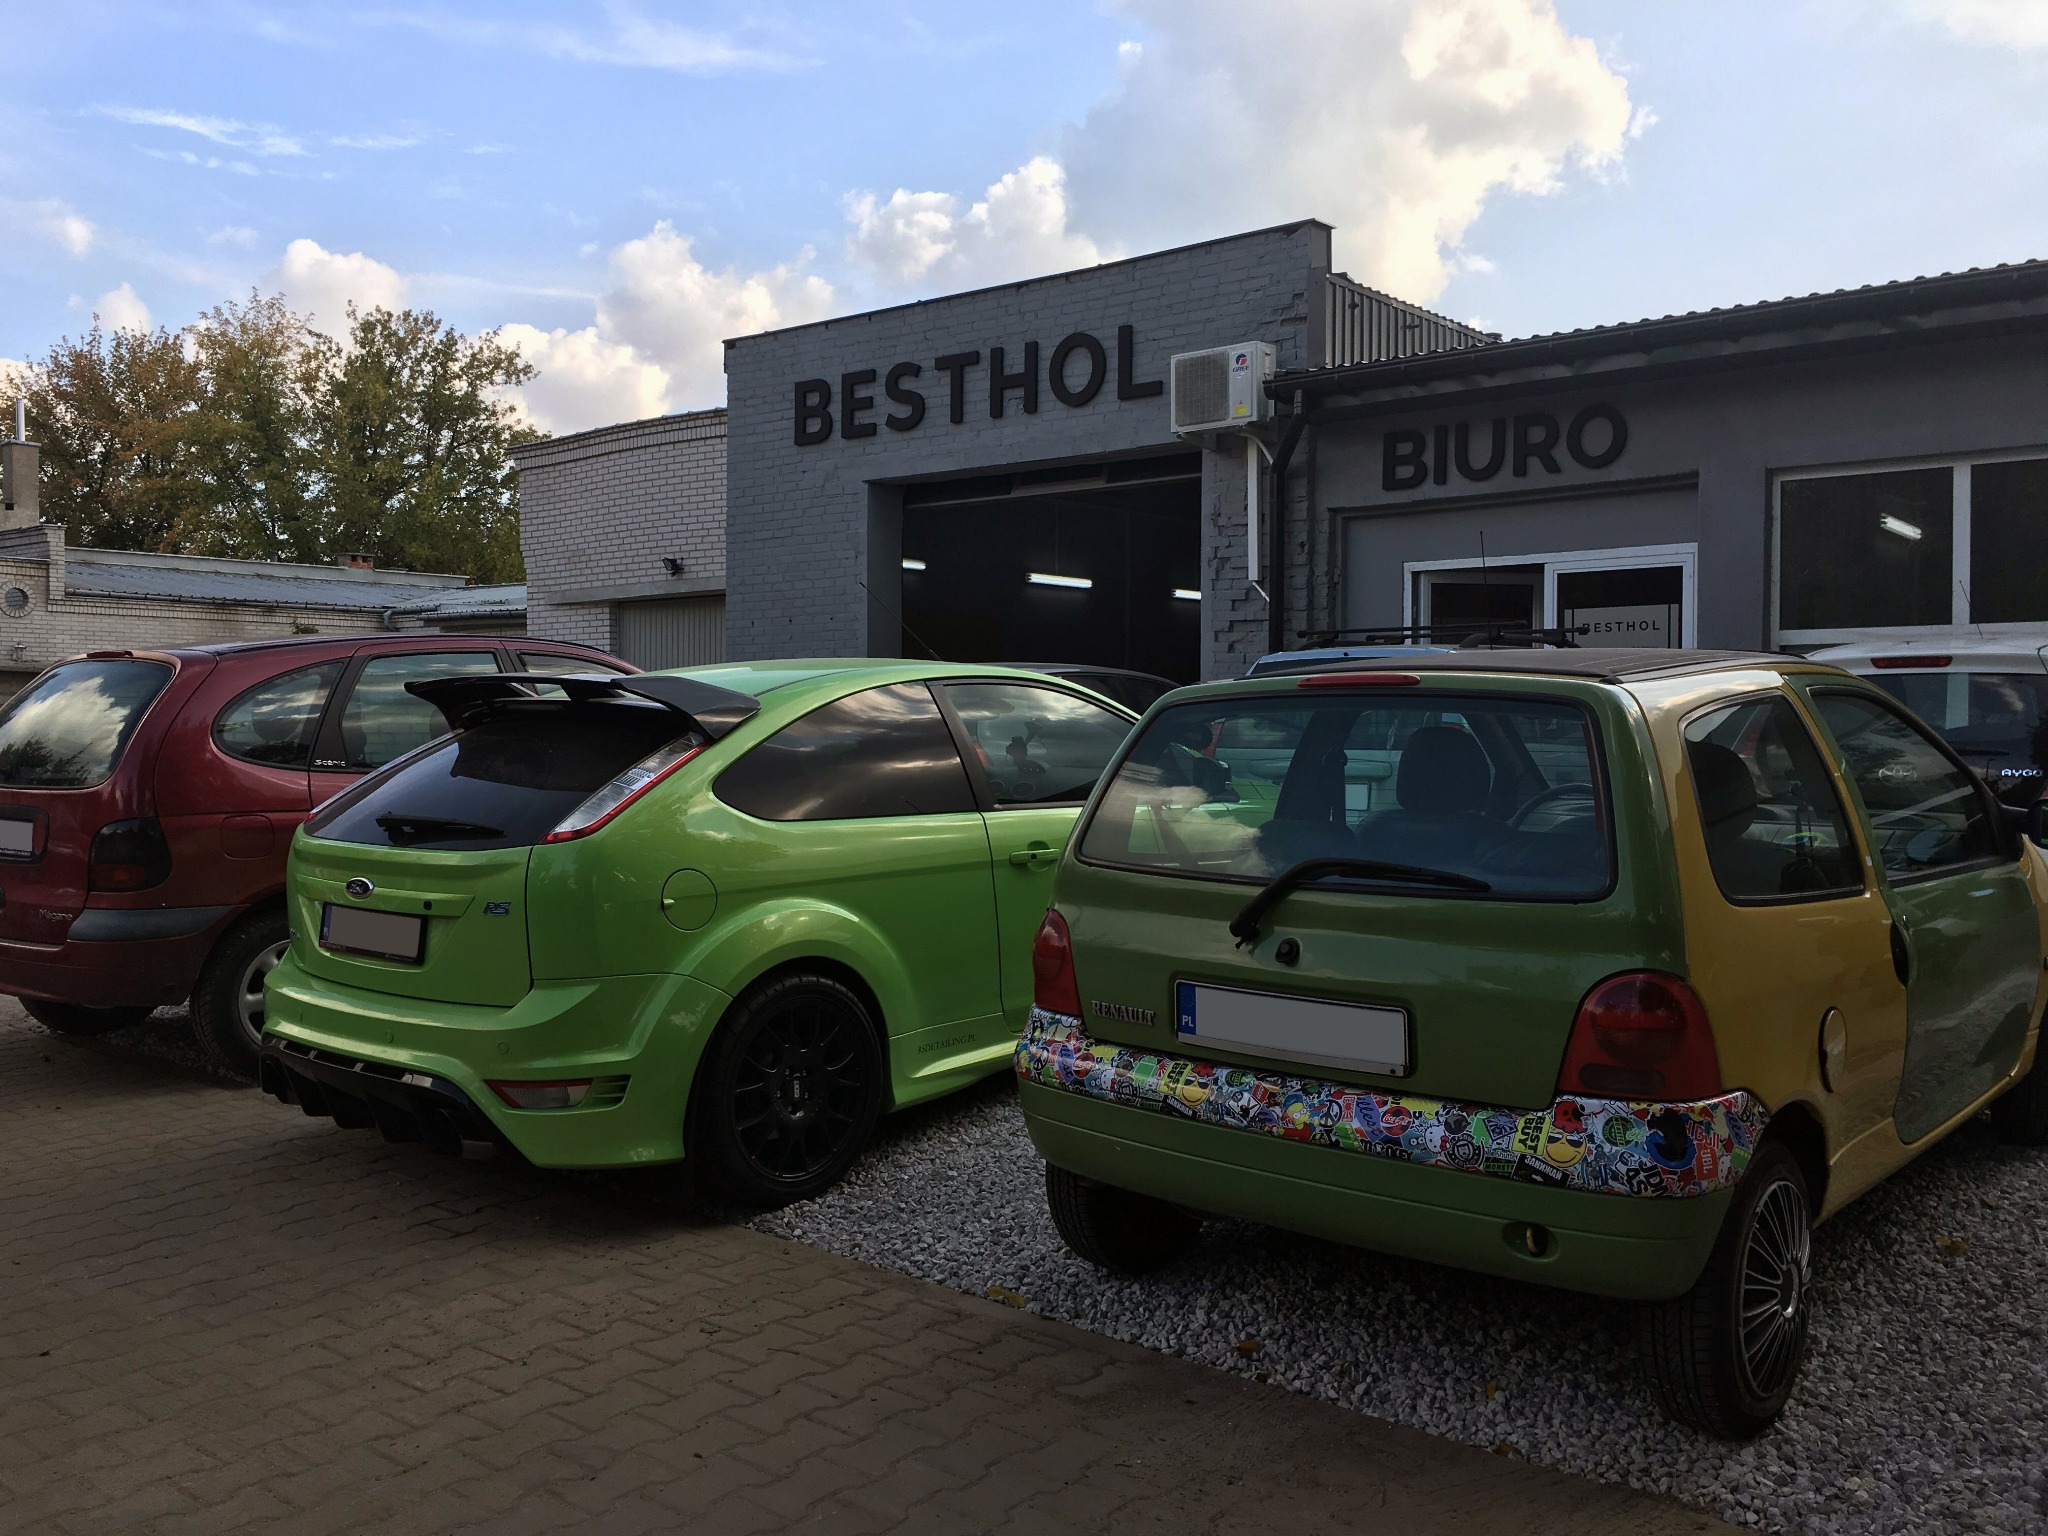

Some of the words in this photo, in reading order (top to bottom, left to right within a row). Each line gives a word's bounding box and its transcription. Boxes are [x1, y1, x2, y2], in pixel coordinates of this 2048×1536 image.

[1231, 364, 1250, 373] GREE
[794, 324, 1163, 446] BESTHOL
[1382, 403, 1628, 491] BIURO
[2001, 768, 2043, 777] AYGO
[482, 900, 512, 915] RS
[1092, 1000, 1154, 1026] RENAULT
[1182, 1014, 1194, 1027] PL
[1518, 1117, 1536, 1149] BUY
[1529, 1116, 1546, 1154] BEST
[1701, 1149, 1713, 1174] JBL
